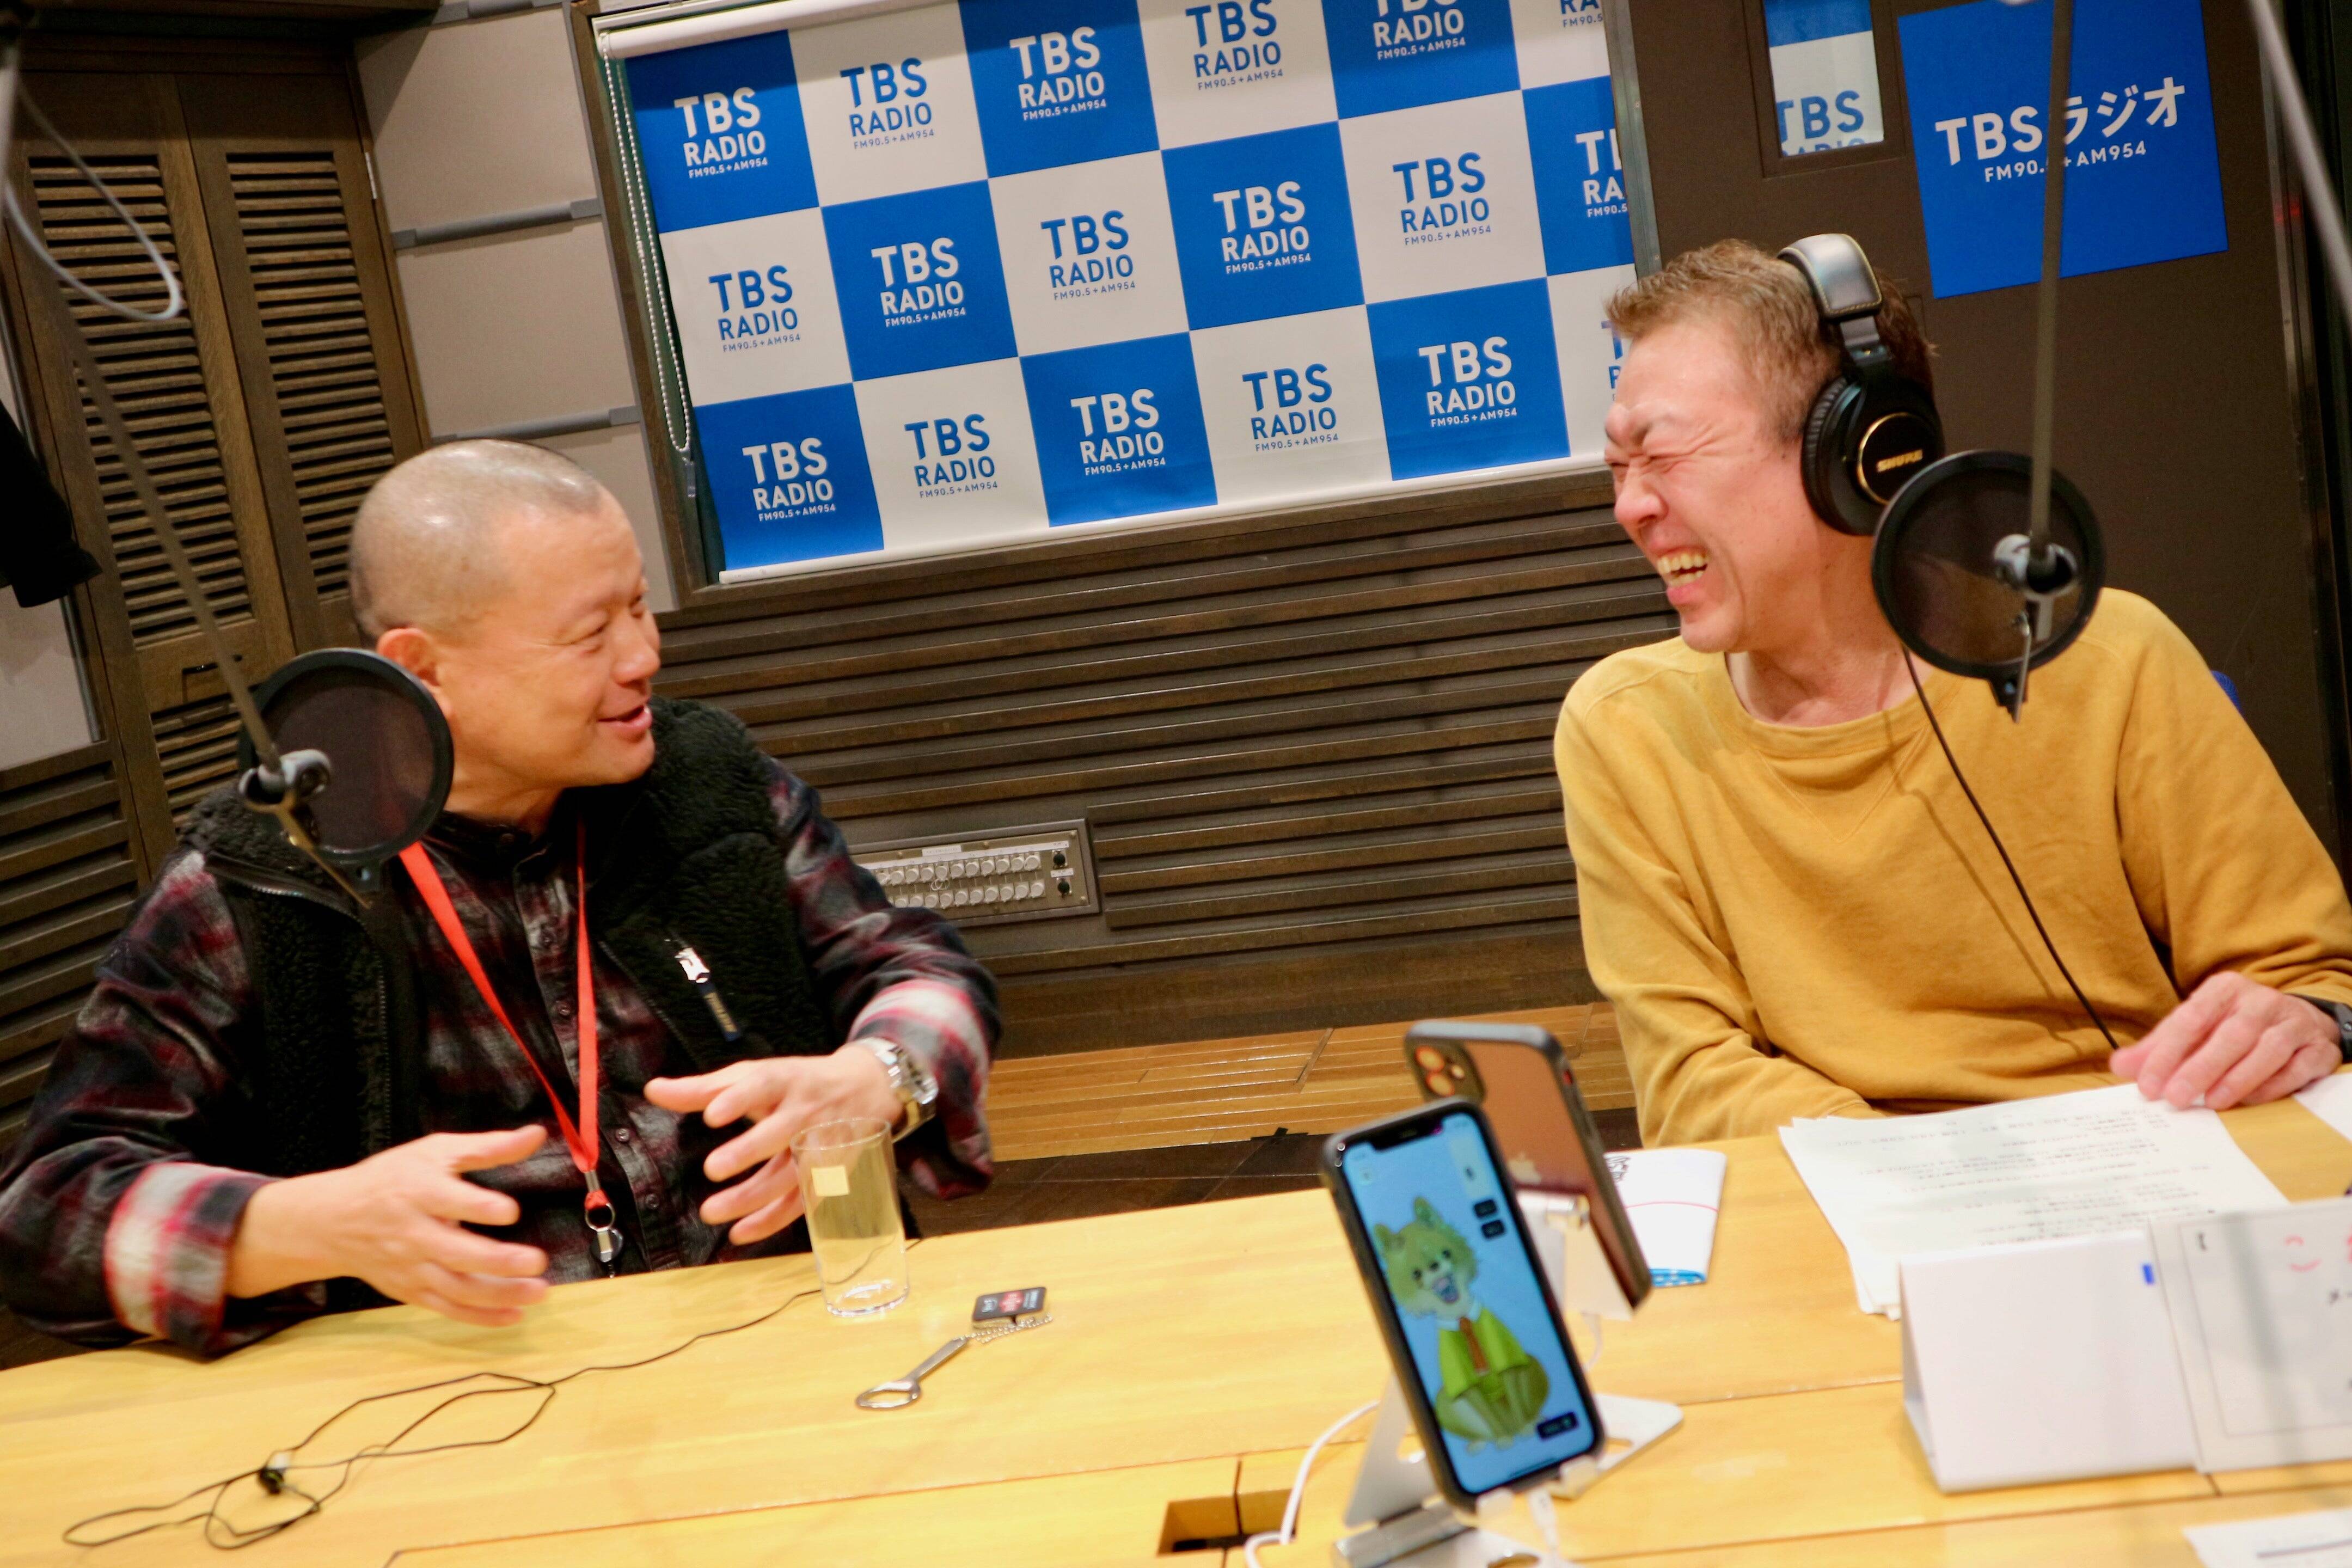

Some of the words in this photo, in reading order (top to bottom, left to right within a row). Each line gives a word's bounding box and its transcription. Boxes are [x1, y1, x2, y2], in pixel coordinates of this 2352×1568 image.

[1186, 0, 1276, 47] TBS
[1373, 9, 1463, 47] RADIO
[1010, 27, 1100, 79] TBS
[1195, 41, 1281, 77] RADIO
[840, 58, 927, 107] TBS
[1019, 72, 1104, 108] RADIO
[675, 87, 760, 137] TBS
[850, 102, 931, 136] RADIO
[1777, 90, 1864, 143] TBS
[684, 131, 765, 166] RADIO
[1935, 106, 2043, 165] TBS
[1393, 152, 1485, 203] TBS
[1213, 181, 1304, 232] TBS
[1401, 198, 1489, 232] RADIO
[1041, 211, 1128, 259] TBS
[1222, 226, 1309, 261] RADIO
[871, 237, 958, 287] TBS
[1050, 255, 1132, 287] RADIO
[709, 266, 792, 313] TBS
[881, 281, 963, 315] RADIO
[719, 308, 797, 340] RADIO
[1419, 336, 1511, 387] TBS
[1242, 364, 1332, 412] TBS
[1427, 381, 1515, 415] RADIO
[1071, 389, 1159, 437] TBS
[1251, 407, 1336, 439] RADIO
[905, 414, 990, 460] TBS
[1080, 432, 1163, 463] RADIO
[743, 438, 827, 483] TBS
[915, 456, 994, 486] RADIO
[753, 479, 833, 510] RADIO
